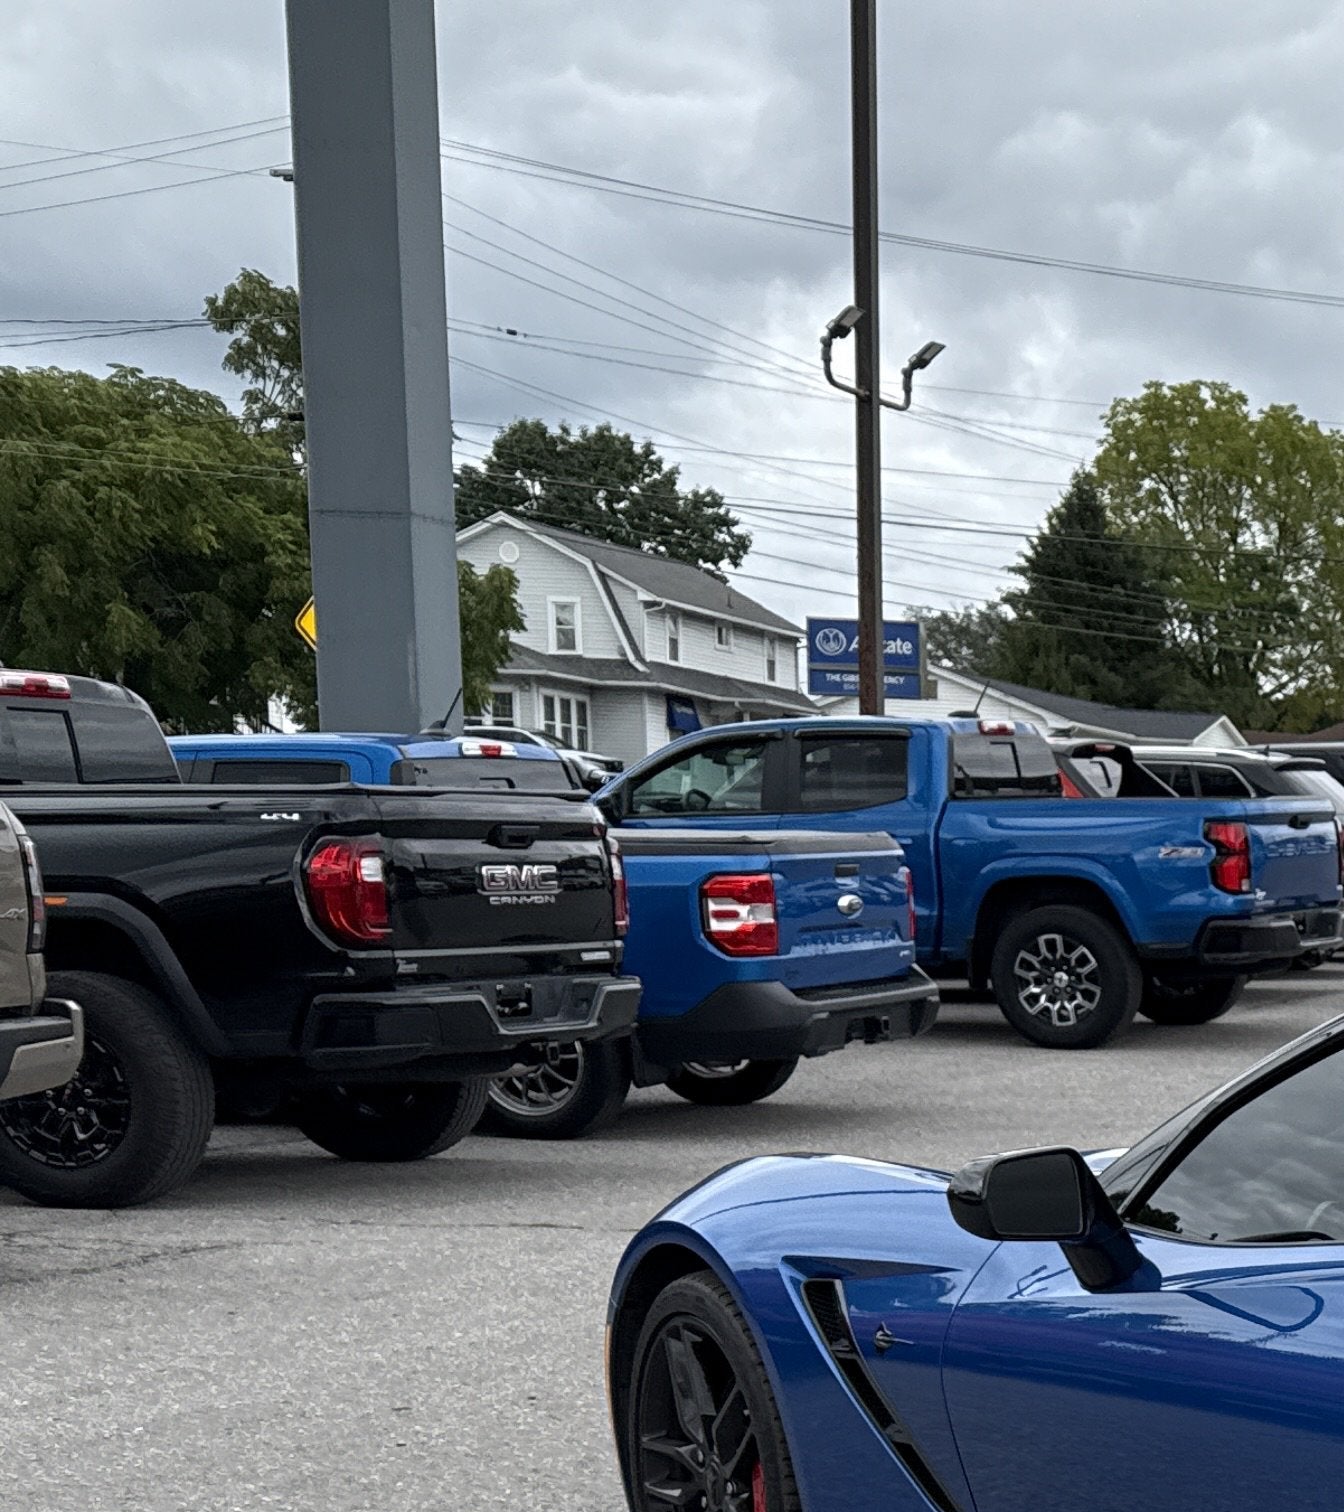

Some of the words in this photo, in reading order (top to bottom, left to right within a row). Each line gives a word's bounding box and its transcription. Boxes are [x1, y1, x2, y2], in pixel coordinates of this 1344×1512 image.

[848, 636, 913, 655] Aate
[481, 864, 559, 891] GMC
[488, 894, 557, 905] CANYON
